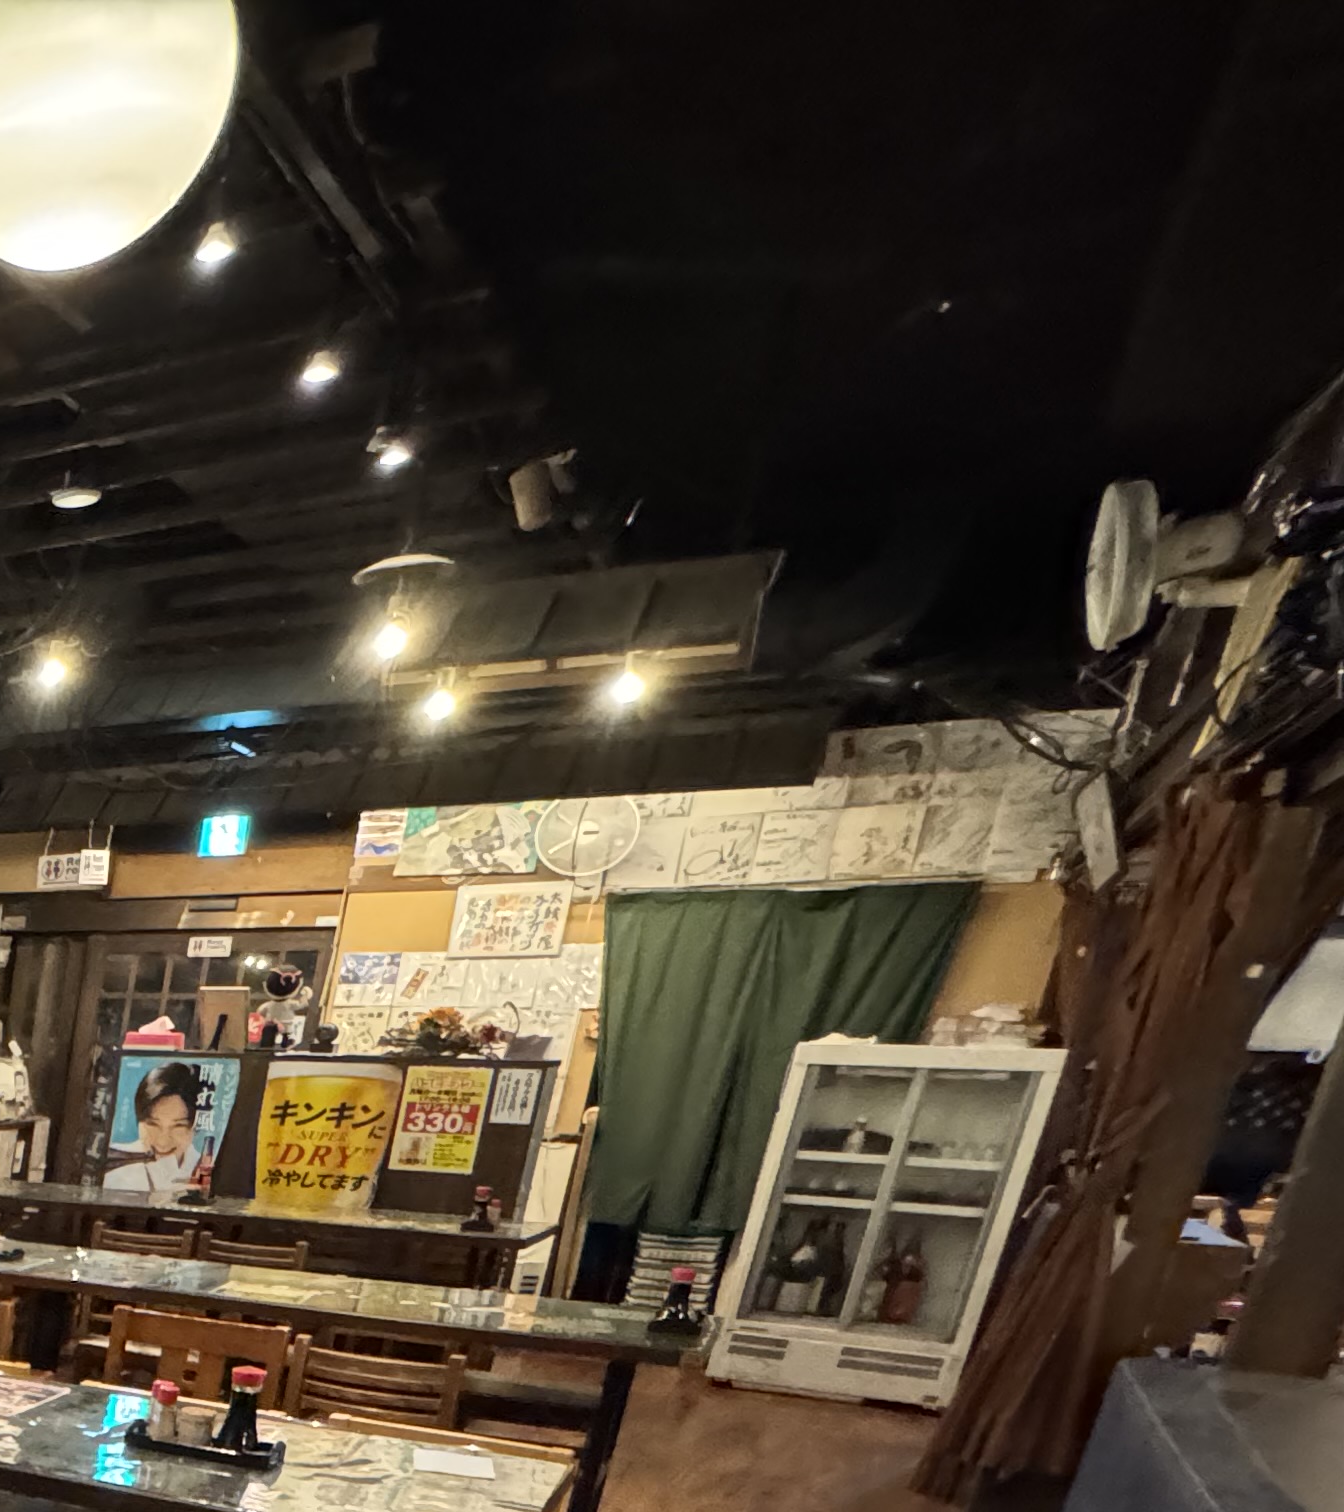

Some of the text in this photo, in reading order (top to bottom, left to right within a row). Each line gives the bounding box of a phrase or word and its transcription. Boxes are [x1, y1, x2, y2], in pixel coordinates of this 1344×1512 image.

[270, 1100, 385, 1129] キンキン
[367, 1125, 387, 1140] に
[262, 1168, 369, 1192] 冷やしてます
